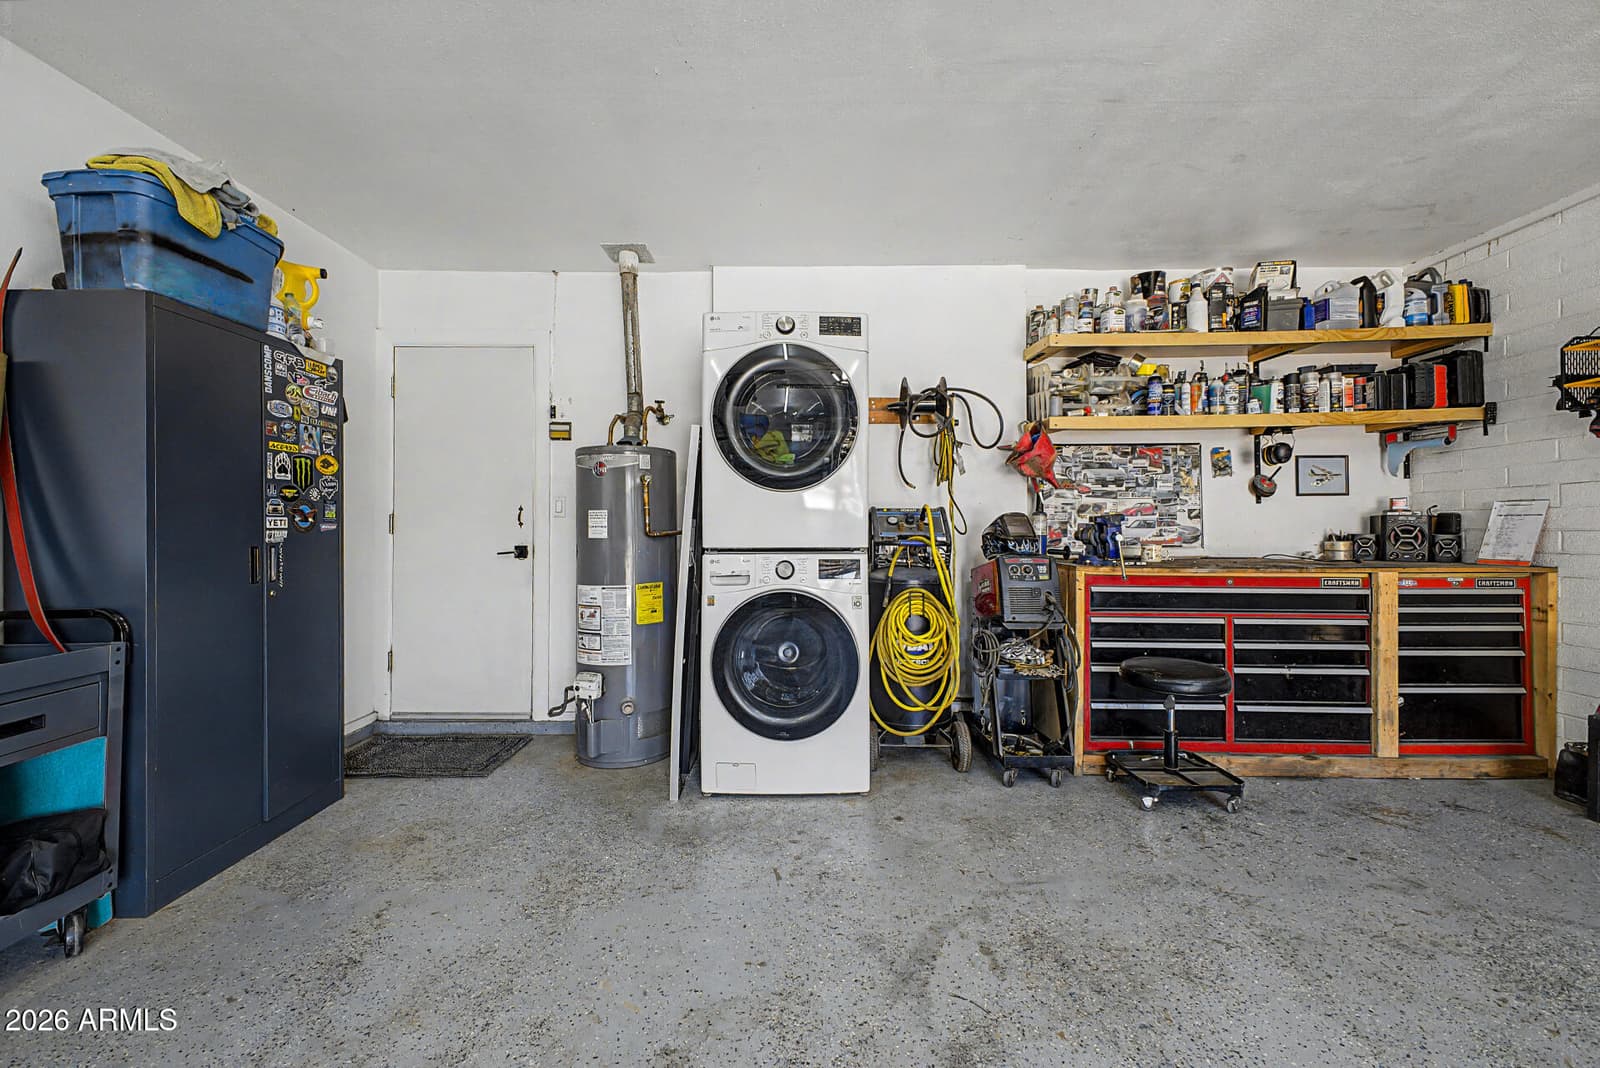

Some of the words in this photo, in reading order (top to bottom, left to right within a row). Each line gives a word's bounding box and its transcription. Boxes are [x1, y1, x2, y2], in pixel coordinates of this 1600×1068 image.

[263, 345, 273, 394] DANSCOMP
[267, 518, 287, 527] YETI
[1324, 579, 1360, 587] CRAFTSMAN
